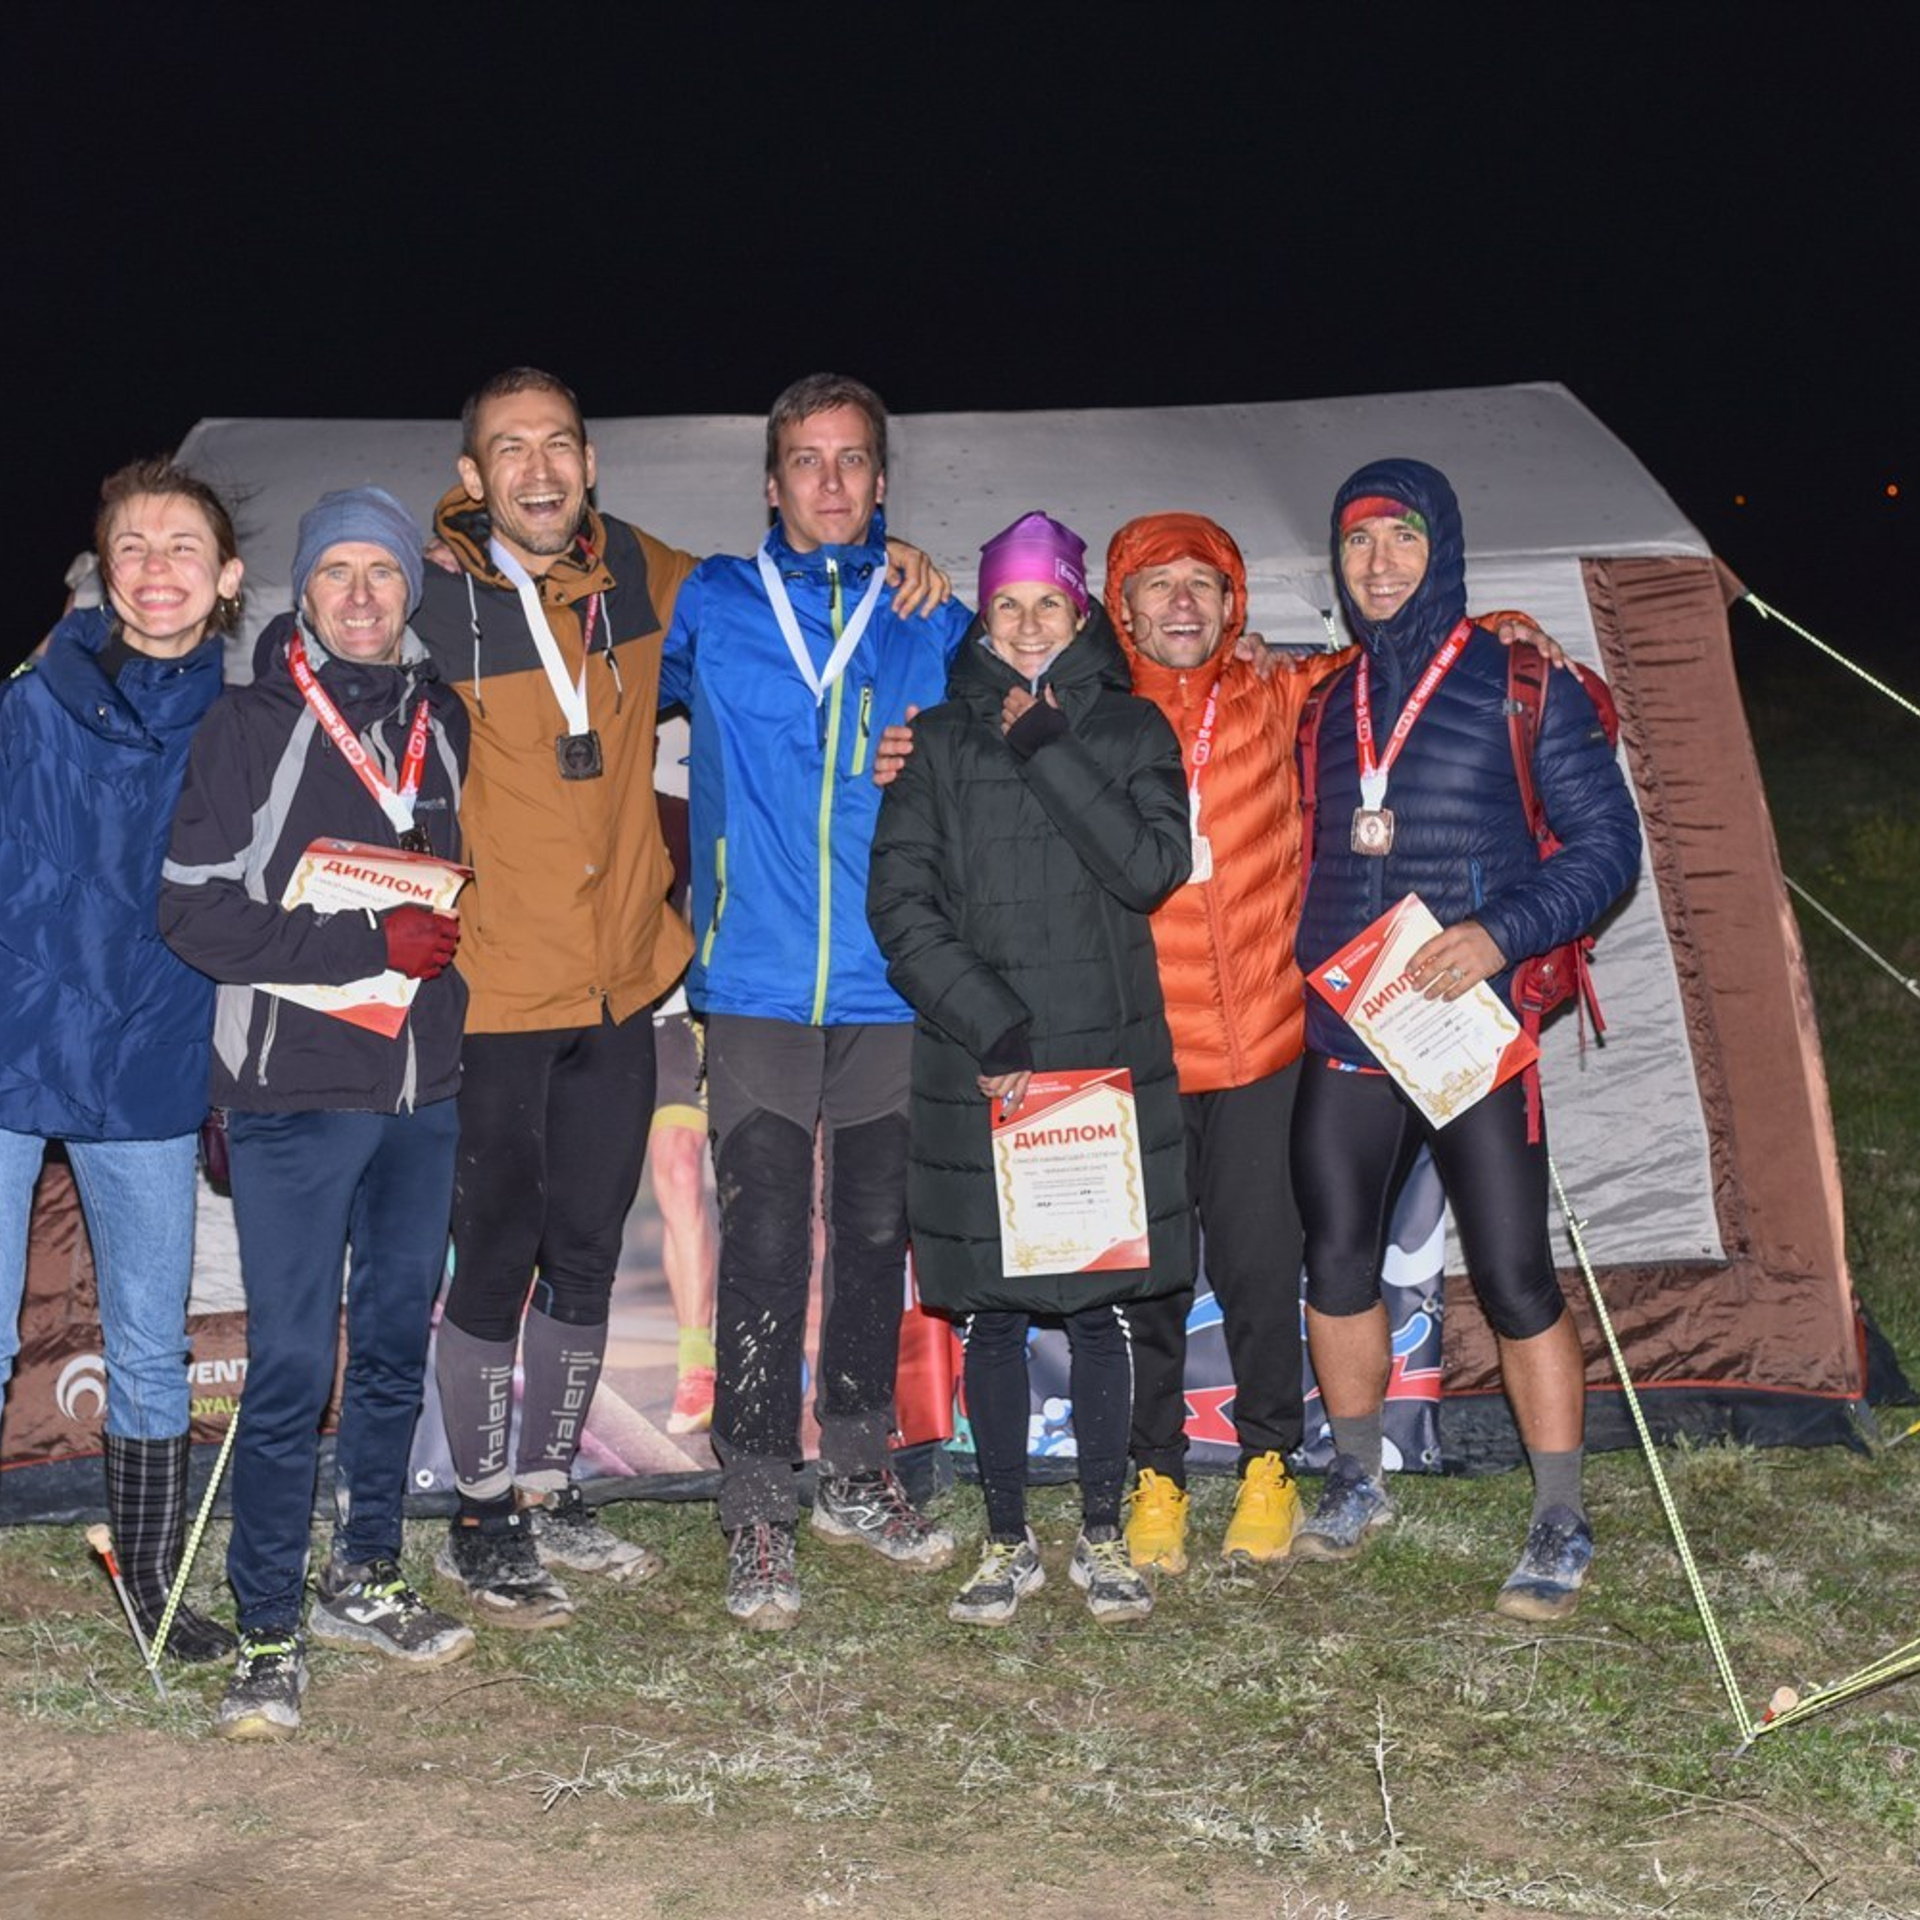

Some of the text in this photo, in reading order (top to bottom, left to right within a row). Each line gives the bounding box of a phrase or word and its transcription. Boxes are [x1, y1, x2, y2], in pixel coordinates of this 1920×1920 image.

[322, 860, 434, 900] ДИПЛОМ
[1362, 970, 1416, 1021] ДИПЛ
[1014, 1123, 1117, 1150] ДИПЛОМ
[542, 1349, 600, 1461] Kalenji
